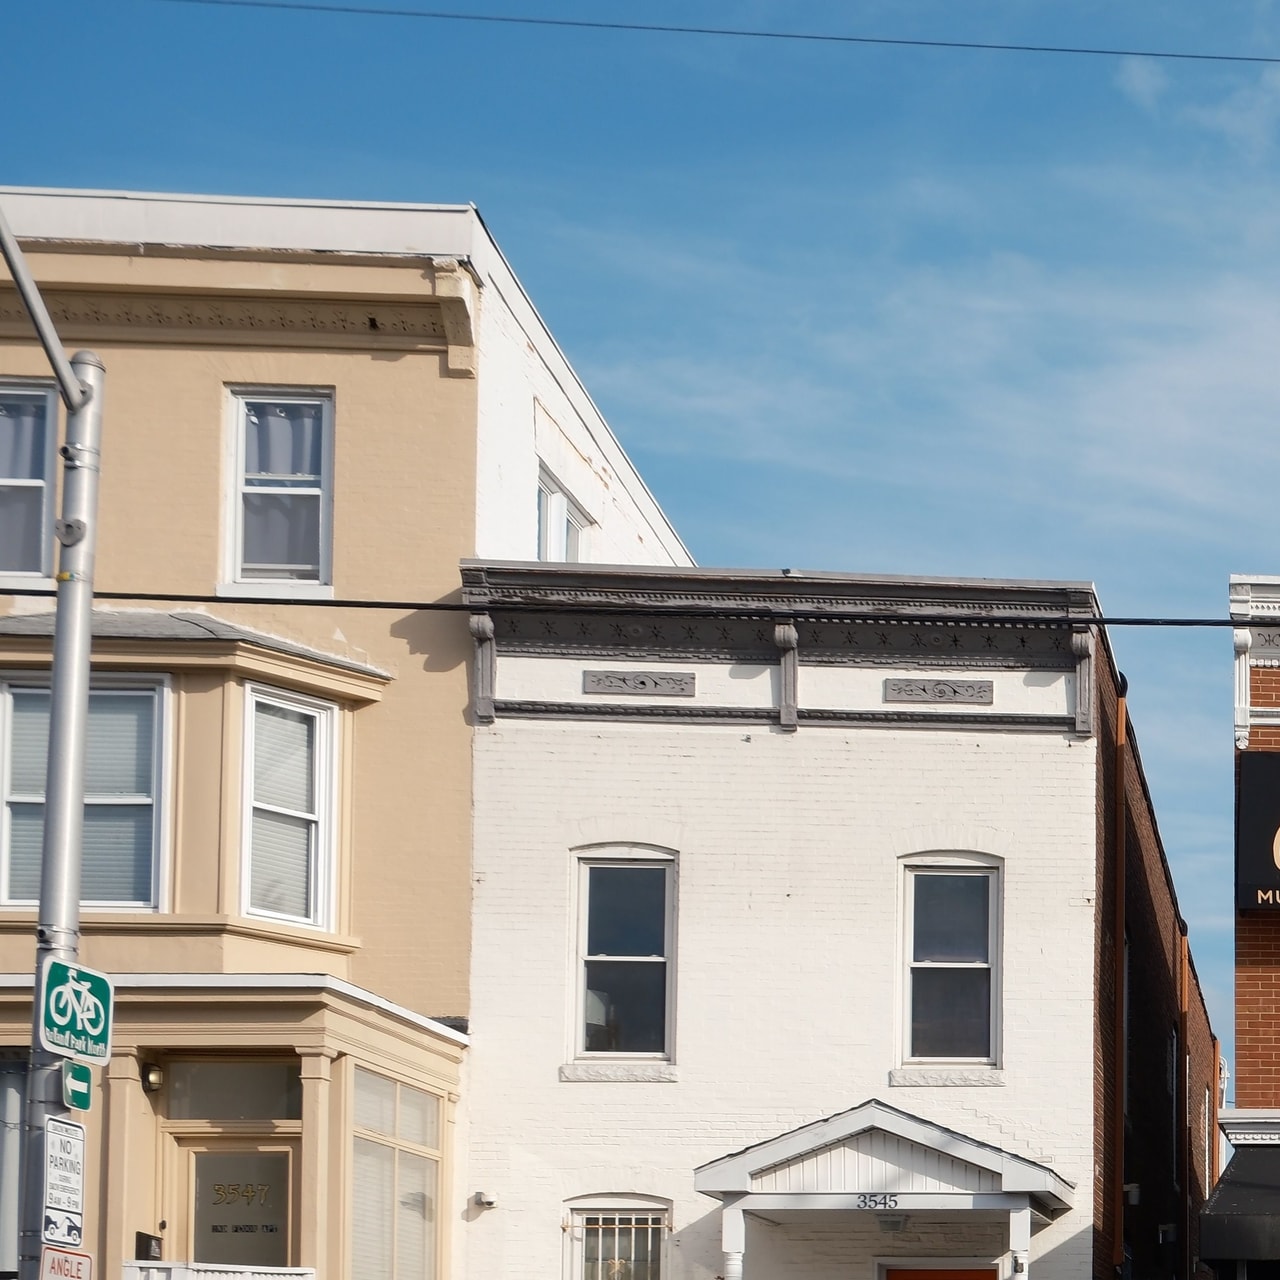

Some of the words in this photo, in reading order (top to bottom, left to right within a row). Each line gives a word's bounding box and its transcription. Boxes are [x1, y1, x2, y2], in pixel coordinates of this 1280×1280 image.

[71, 1033, 87, 1052] Park
[88, 1037, 106, 1057] North
[60, 1138, 72, 1155] NO
[49, 1154, 81, 1175] PARKING
[212, 1184, 270, 1206] 3547
[857, 1194, 898, 1209] 3545
[49, 1256, 83, 1279] ANGLE
